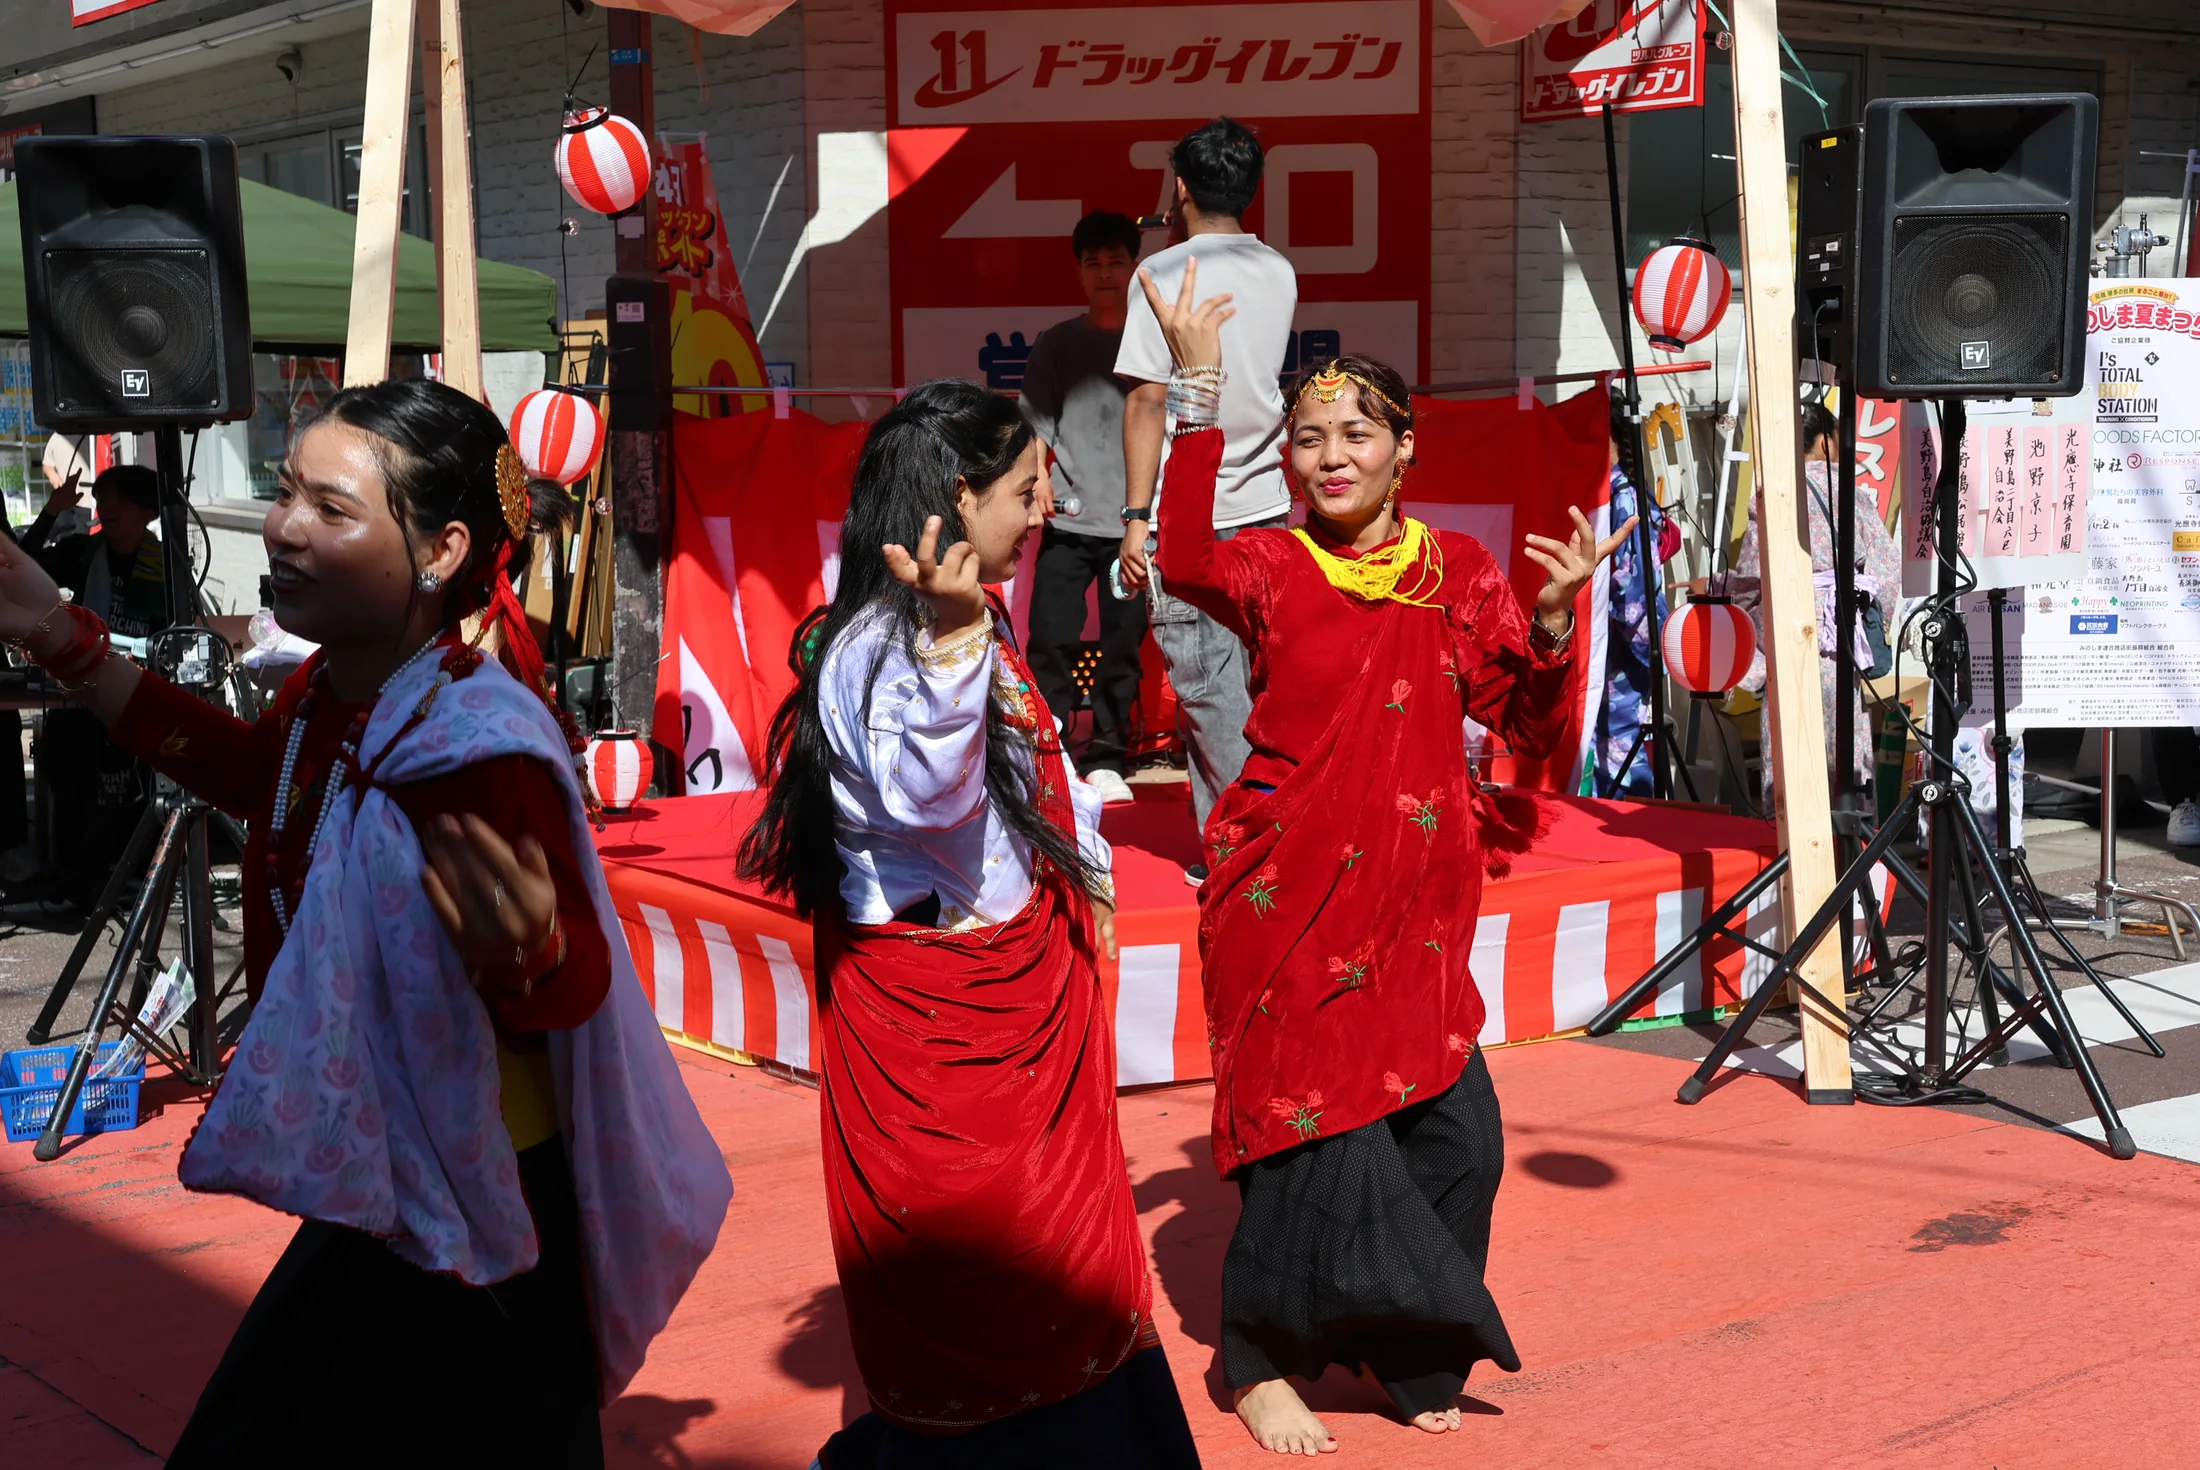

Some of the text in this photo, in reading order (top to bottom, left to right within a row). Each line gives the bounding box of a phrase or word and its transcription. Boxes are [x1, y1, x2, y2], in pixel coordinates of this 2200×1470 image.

[1032, 33, 1403, 88] ドラッグイレブン
[1632, 44, 1691, 62] ツルハグループ
[1532, 66, 1686, 107] ドラッグイレブン
[2087, 303, 2200, 337] のしま夏まつ
[2099, 352, 2117, 367] I's
[2100, 368, 2143, 382] TOTAL
[2098, 383, 2139, 398] BODY
[2097, 398, 2158, 413] STATION
[2093, 430, 2140, 443] OODS
[2144, 457, 2198, 465] RESPONSE
[2028, 439, 2045, 543] 池野京子
[2088, 556, 2118, 570] 藤家
[1972, 605, 1985, 613] AIR
[2080, 596, 2109, 609] Happy
[2120, 600, 2168, 608] NEOPRINTING
